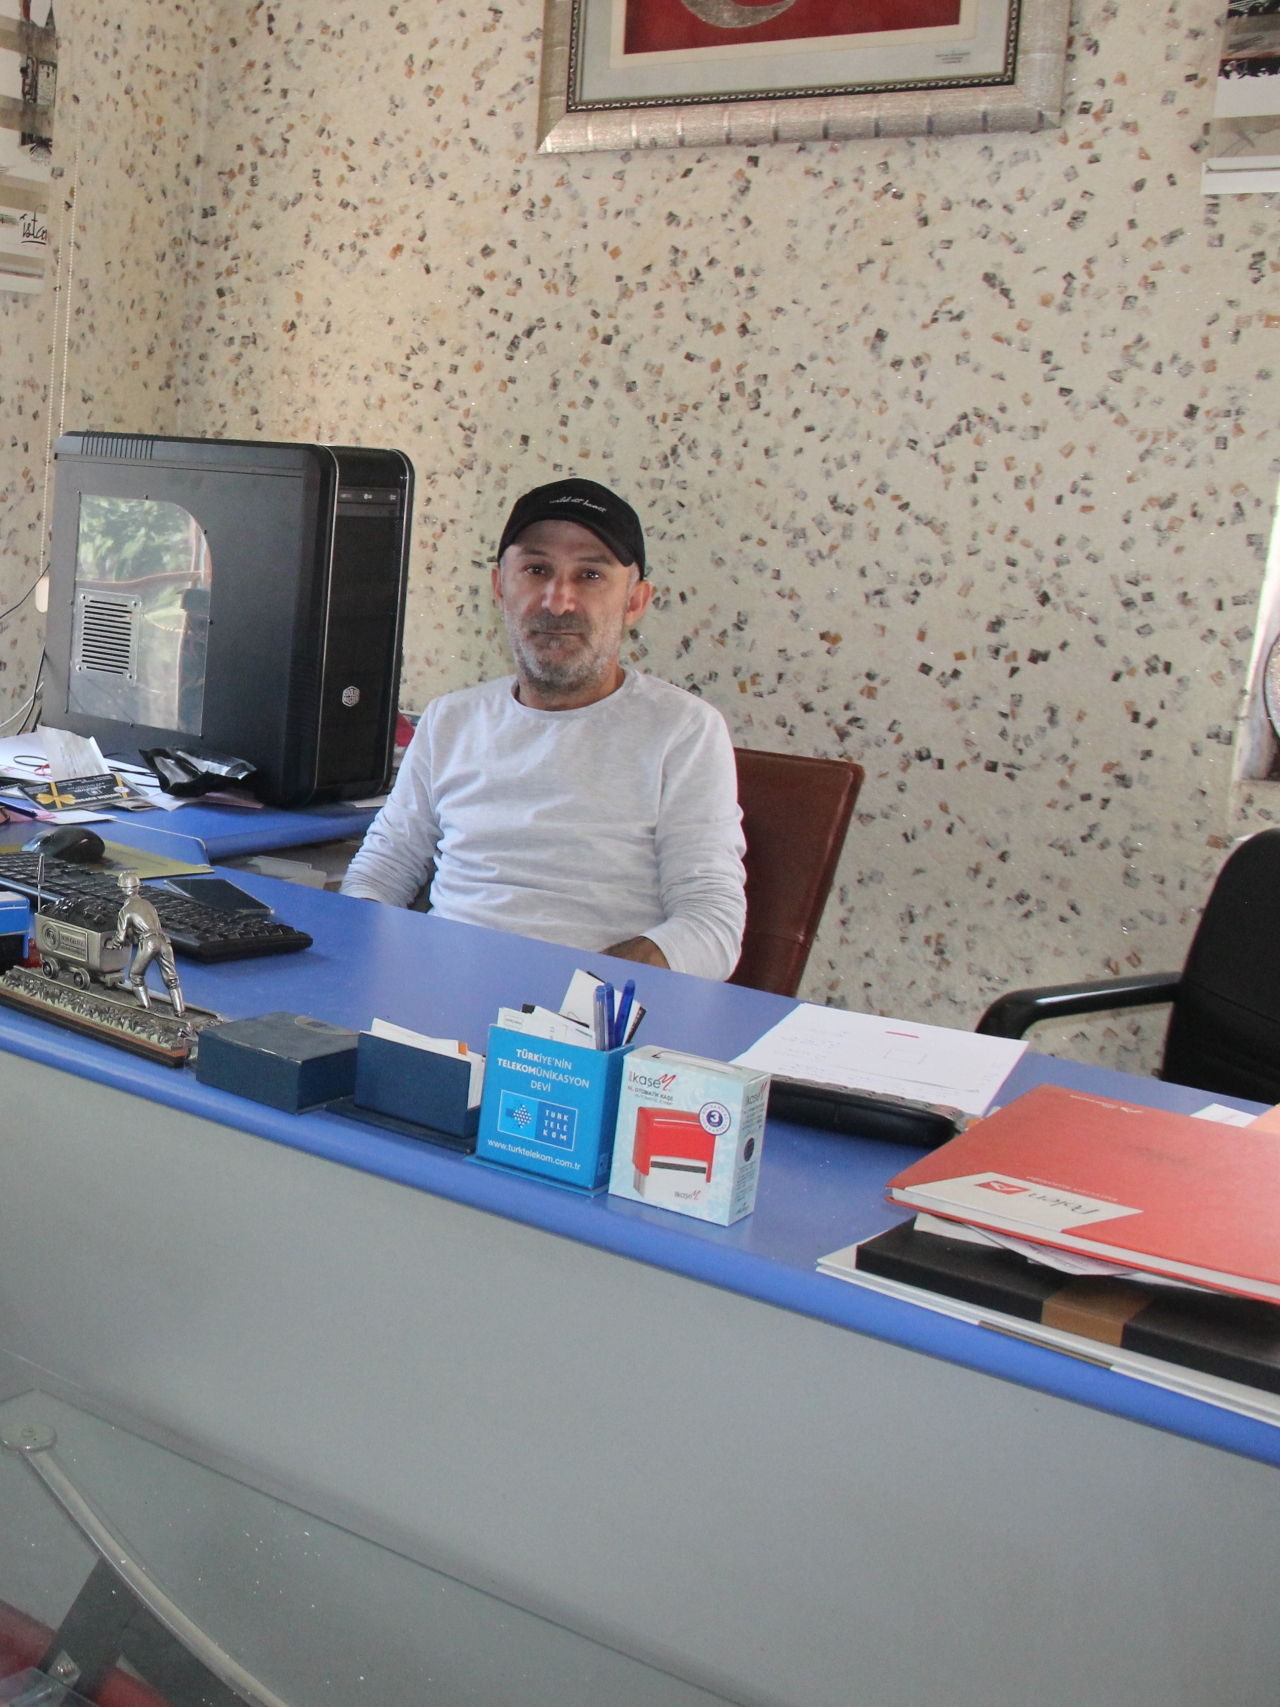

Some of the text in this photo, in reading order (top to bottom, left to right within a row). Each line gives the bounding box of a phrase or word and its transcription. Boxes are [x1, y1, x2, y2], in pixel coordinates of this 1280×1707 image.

[516, 1048, 572, 1071] TÜRKİYE'NİN
[497, 1057, 590, 1089] TELEKOMÜNİKASYON
[530, 1080, 552, 1093] DEVİ
[710, 1111, 720, 1123] 3
[544, 1119, 568, 1132] TELE
[543, 1129, 568, 1141] KOM
[487, 1139, 582, 1170] www.turktelekom.com.tr
